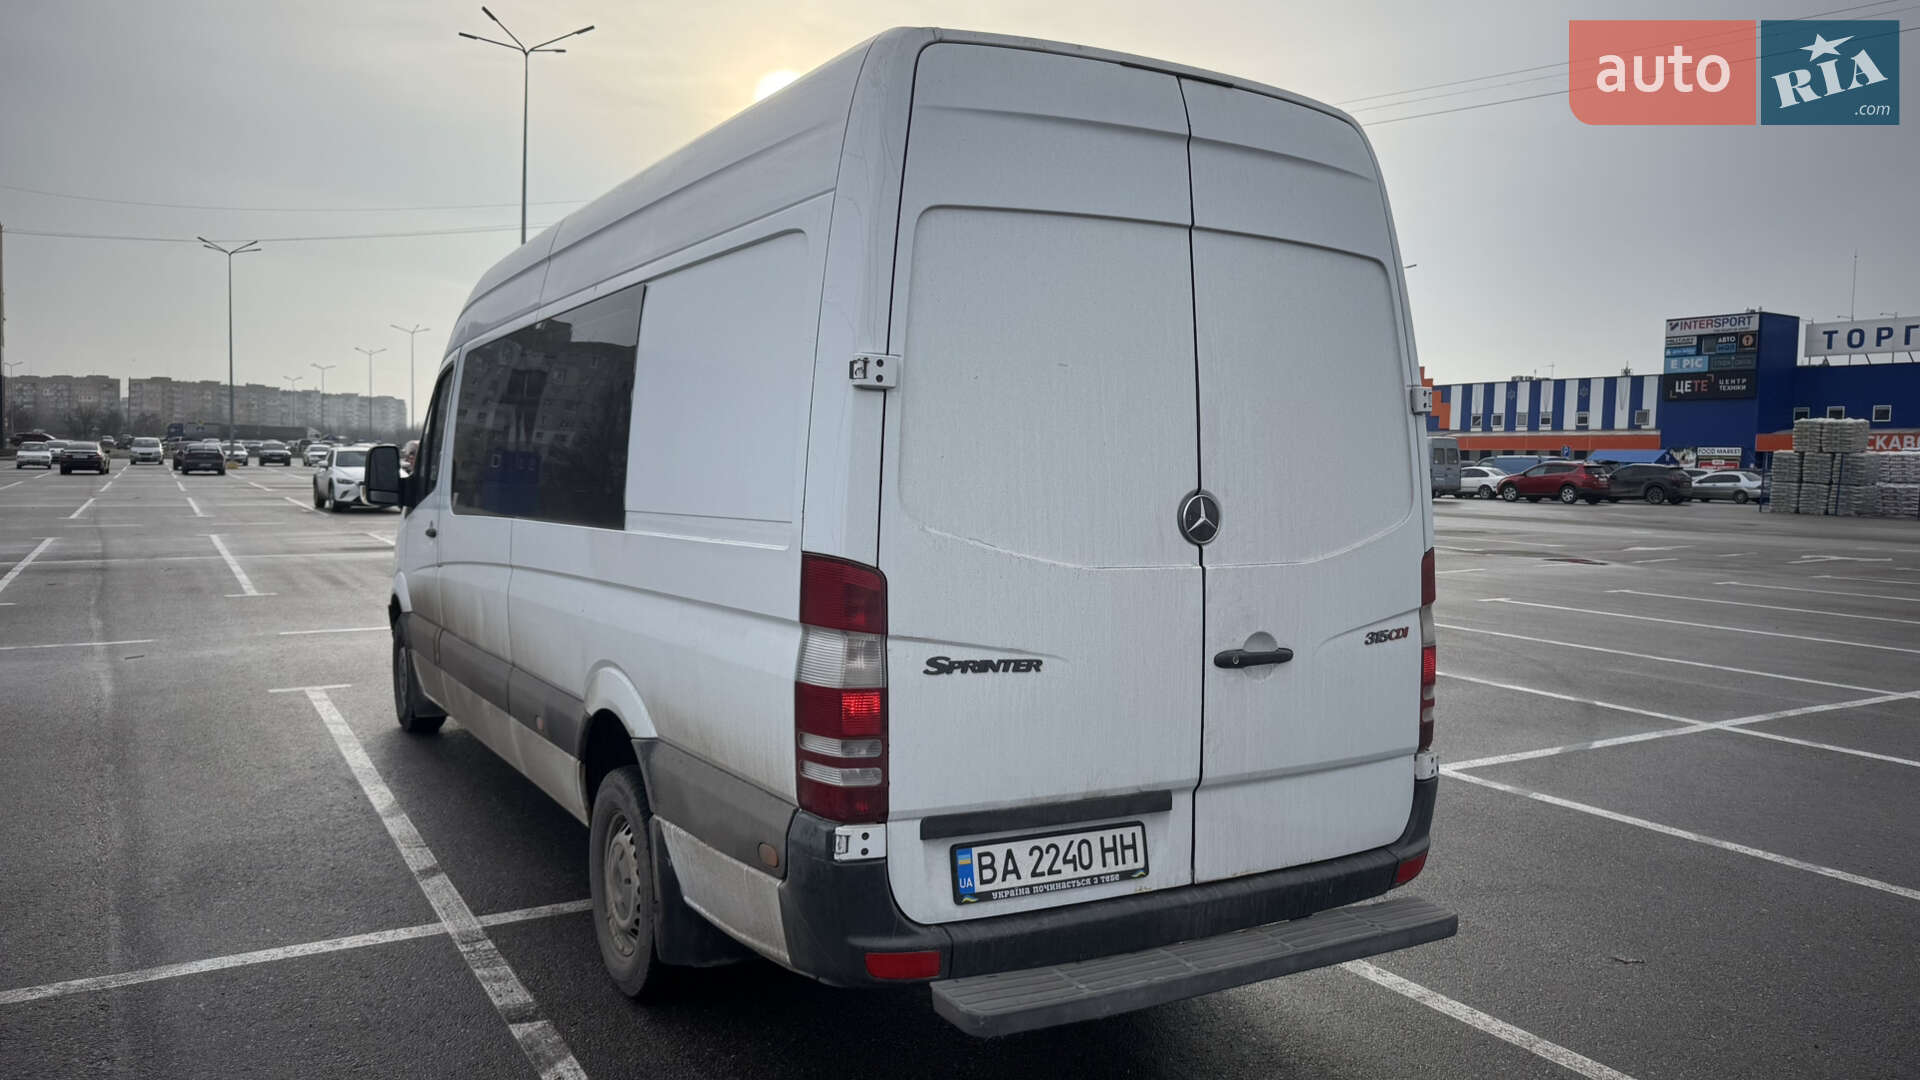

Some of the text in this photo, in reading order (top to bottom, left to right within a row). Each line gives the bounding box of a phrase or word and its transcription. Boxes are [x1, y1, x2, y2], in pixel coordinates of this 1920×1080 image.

[1680, 316, 1753, 331] INTERSPORT
[1675, 380, 1708, 394] ЦЕТЕ
[977, 832, 1138, 886] BA 2240 HH
[959, 877, 974, 889] UA
